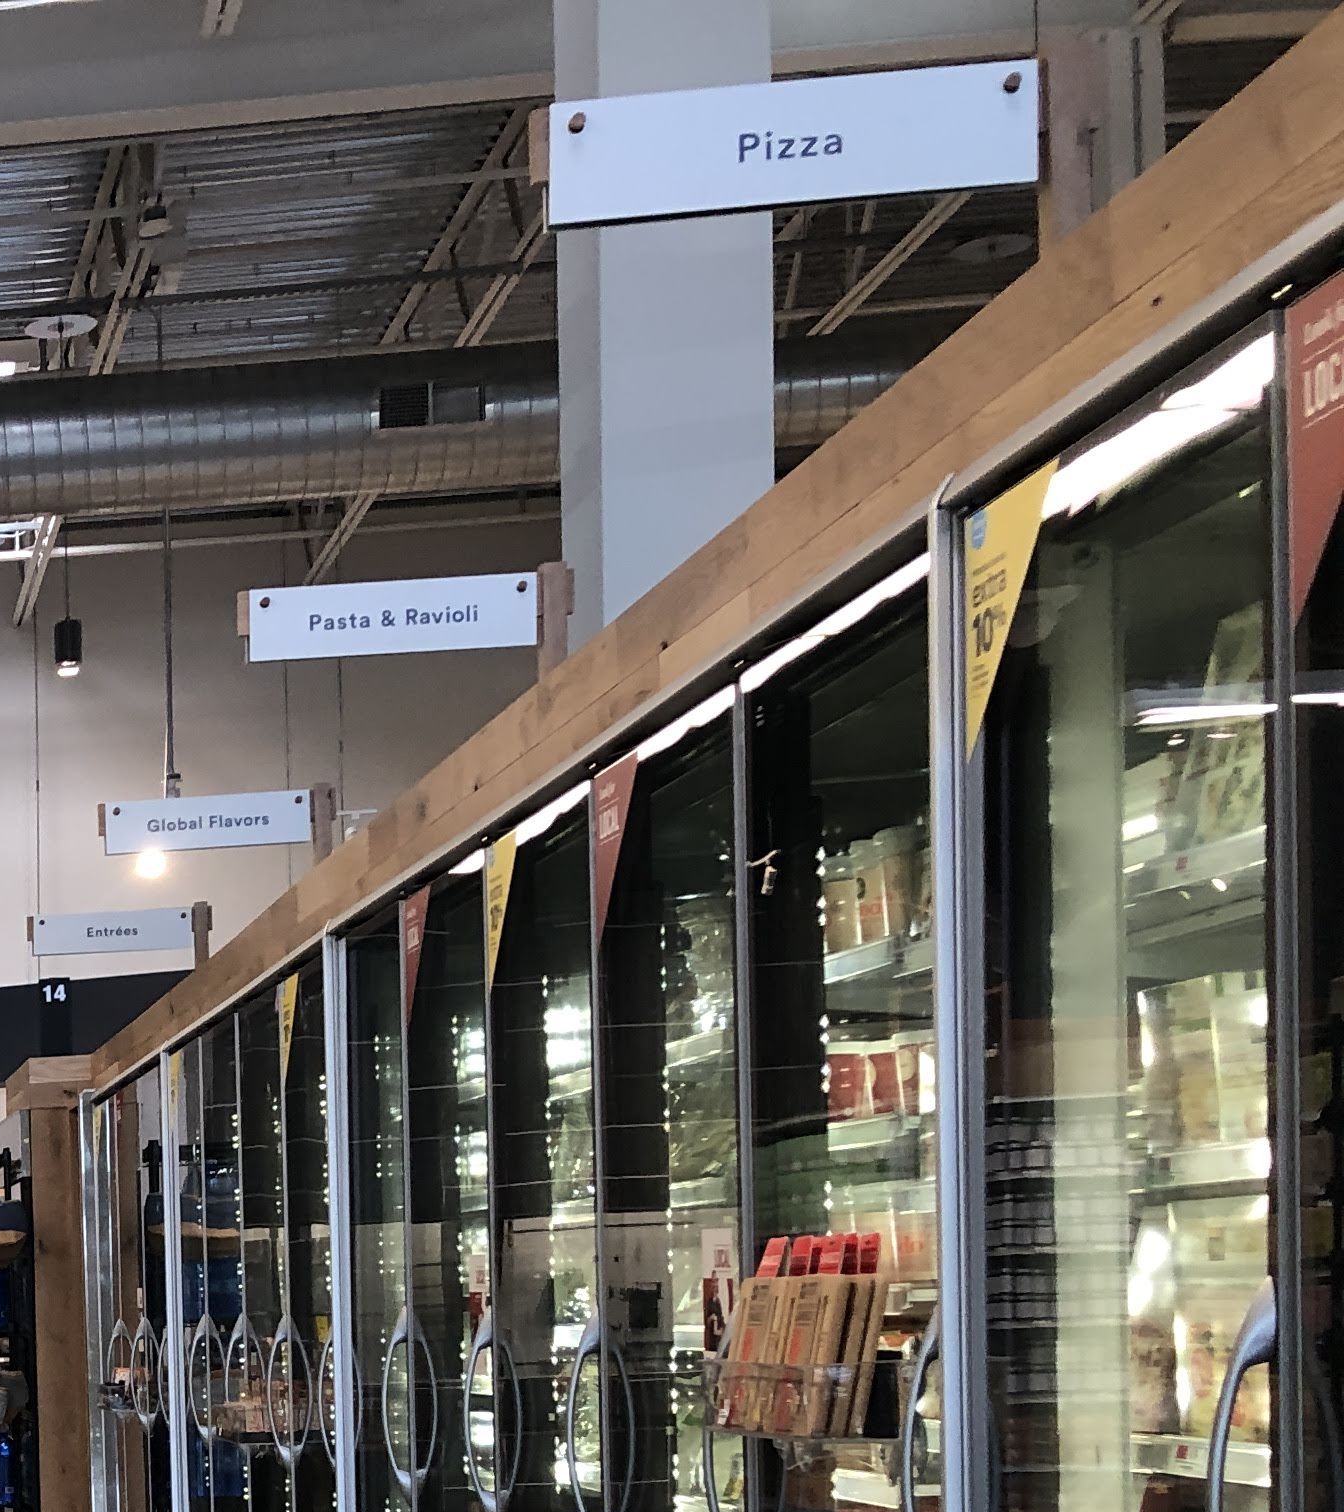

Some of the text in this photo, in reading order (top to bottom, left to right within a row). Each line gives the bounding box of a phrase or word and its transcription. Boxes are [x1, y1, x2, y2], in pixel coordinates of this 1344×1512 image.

[738, 130, 843, 163] Pizza
[309, 604, 479, 632] Pasta & Ravioli
[147, 814, 270, 832] Global Flavors
[86, 926, 139, 938] Entrées
[42, 984, 67, 1003] 14
